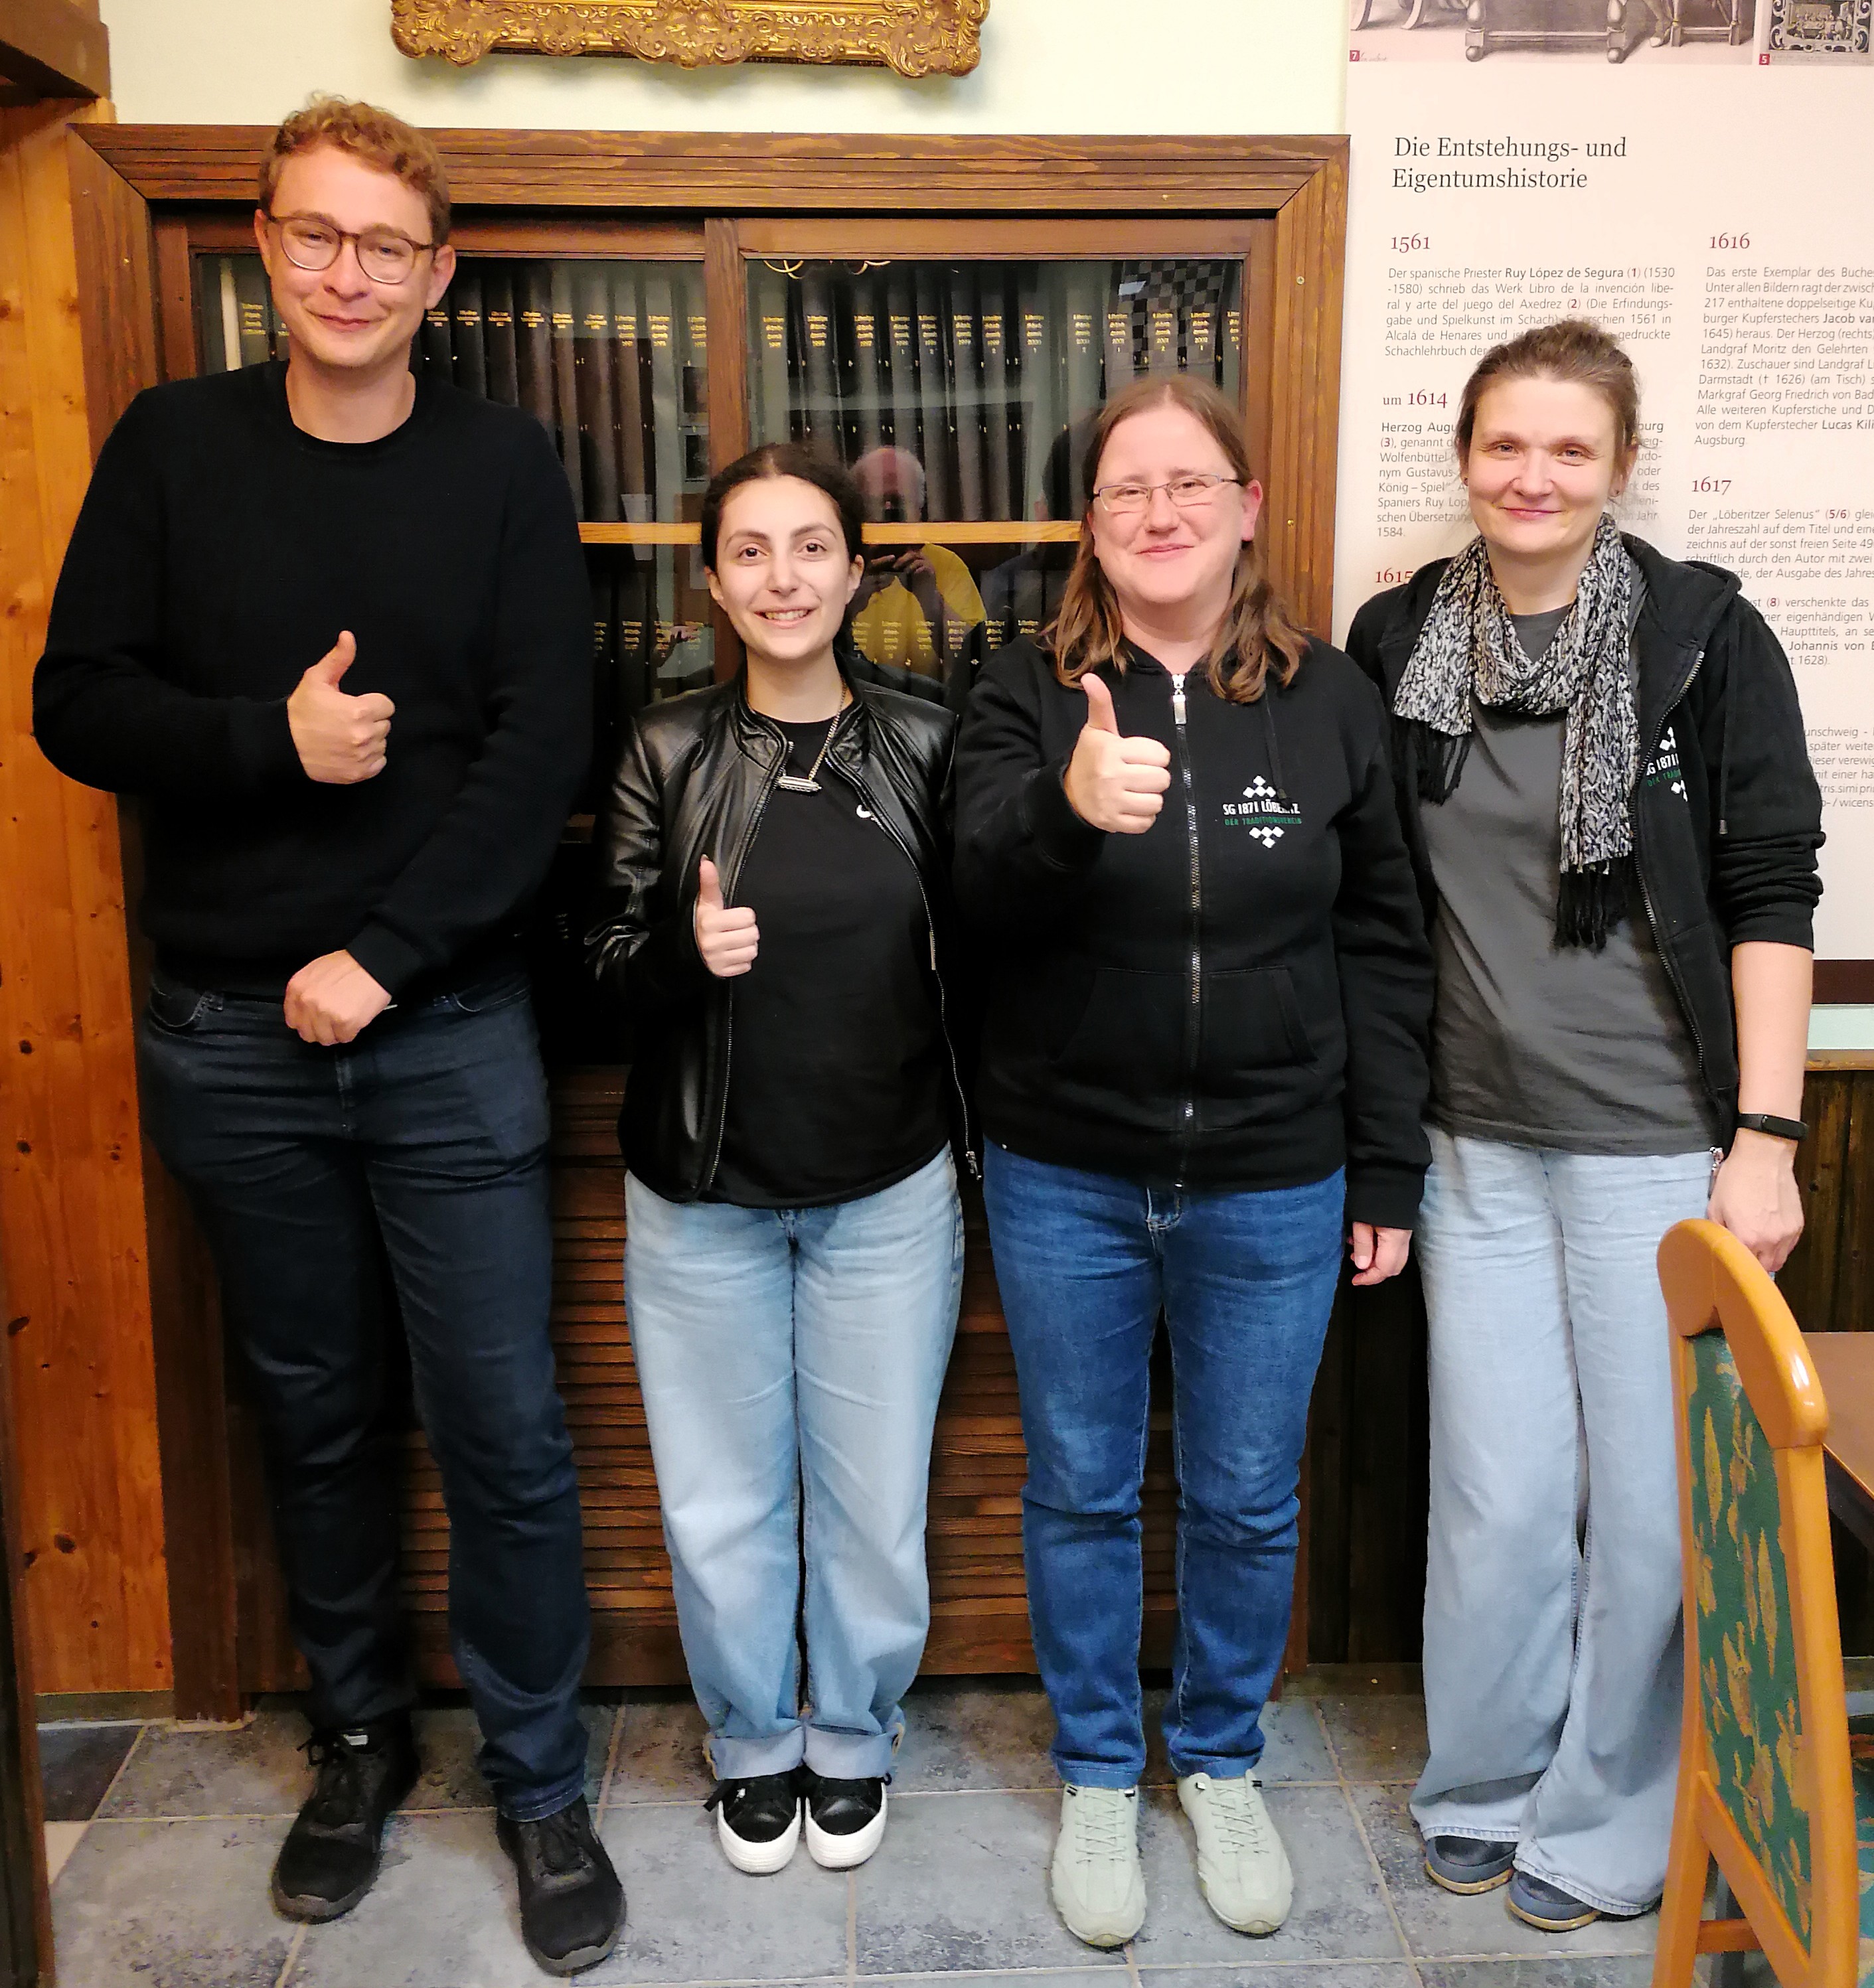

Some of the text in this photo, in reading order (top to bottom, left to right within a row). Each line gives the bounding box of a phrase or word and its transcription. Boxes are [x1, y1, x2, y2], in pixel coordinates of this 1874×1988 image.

[1394, 136, 1626, 161] Die Entstehungs- und
[1391, 167, 1587, 192] Eigentumshistorie
[1391, 233, 1430, 253] 1561
[1709, 232, 1750, 249] 1616
[1388, 267, 1675, 280] Der spanische Priester Ruy López de Segura (1) (1530
[1706, 267, 1725, 277] Das
[1731, 268, 1757, 277] erste
[1763, 266, 1812, 279] Exemplar
[1817, 267, 1835, 277] des
[1387, 283, 1674, 295] -1580) schrieb das Werk Libro de la invención libe-
[1705, 281, 1841, 295] Unter allen Bildern ragt der
[1387, 298, 1672, 312] ral arte del juego del Axedrez (2) (Die Erfindungs-
[1704, 297, 1855, 311] 217 enthaltene doppelseitige
[1386, 314, 1495, 327] gabe und Spielkunst
[1631, 314, 1655, 324] 1561
[1703, 313, 1855, 325] burger Kupferstechers Jacob
[1421, 330, 1435, 340] de
[1440, 331, 1482, 340] Henares
[1487, 330, 1509, 340] und
[1617, 329, 1670, 343] gedruckte
[1703, 329, 1733, 340] 1645)
[1776, 329, 1795, 339] Der
[1798, 329, 1835, 341] Herzog
[1385, 345, 1466, 356] Schachlehrbuch
[1701, 343, 1868, 356] Landgraf Moritz den Gelehrten
[1701, 358, 1865, 372] 1632). Zuschauer sind Landgraf
[1699, 374, 1865, 386] Darmstadt 1626) (am Tisch)
[1407, 389, 1447, 408] 1614
[1697, 388, 1747, 402] Markgraf
[1749, 390, 1782, 402] Georg
[1784, 389, 1828, 399] Friedrich
[1695, 404, 1862, 417] Alle weiteren Kupferstiche und
[1381, 422, 1421, 434] Herzog
[1718, 420, 1741, 429] dem
[1745, 419, 1818, 431] Kupferstecher
[1822, 420, 1852, 429] Lucas
[1380, 437, 1445, 451] (3), genannt
[1379, 451, 1448, 463] Wolfenbüttel
[1379, 467, 1453, 479] nym Gustavus
[1635, 467, 1661, 476] oder
[1378, 483, 1408, 495] König
[1642, 480, 1659, 491] des
[1691, 477, 1731, 495] 1617
[1377, 497, 1446, 510] Spaniers Ruy
[1377, 512, 1406, 522] schen
[1688, 510, 1707, 519] Der
[1825, 510, 1850, 520] (5/6)
[1377, 527, 1406, 537] 1584.
[1687, 524, 1853, 534] der Jahreszahl auf dem Titel und
[1685, 538, 1857, 549] zeichnis auf der sonst freien Seite
[1738, 553, 1767, 563] durch
[1771, 553, 1790, 563] den
[1794, 554, 1825, 563] Autor
[1828, 554, 1845, 563] mit
[1847, 554, 1872, 563] zwei
[1375, 568, 1413, 585] 1615
[1755, 568, 1773, 577] der
[1775, 568, 1821, 580] Ausgabe
[1824, 568, 1841, 577] des
[1766, 597, 1869, 608] (8) verschenkte das
[1786, 611, 1863, 624] eigenhändigen
[1780, 626, 1838, 639] Haupttitels,
[1788, 641, 1837, 650] Johannis
[1798, 655, 1830, 666] 1628).
[1810, 741, 1841, 752] später
[1832, 771, 1857, 779] einer
[1223, 804, 1235, 815] SG
[1238, 801, 1259, 814] 1871
